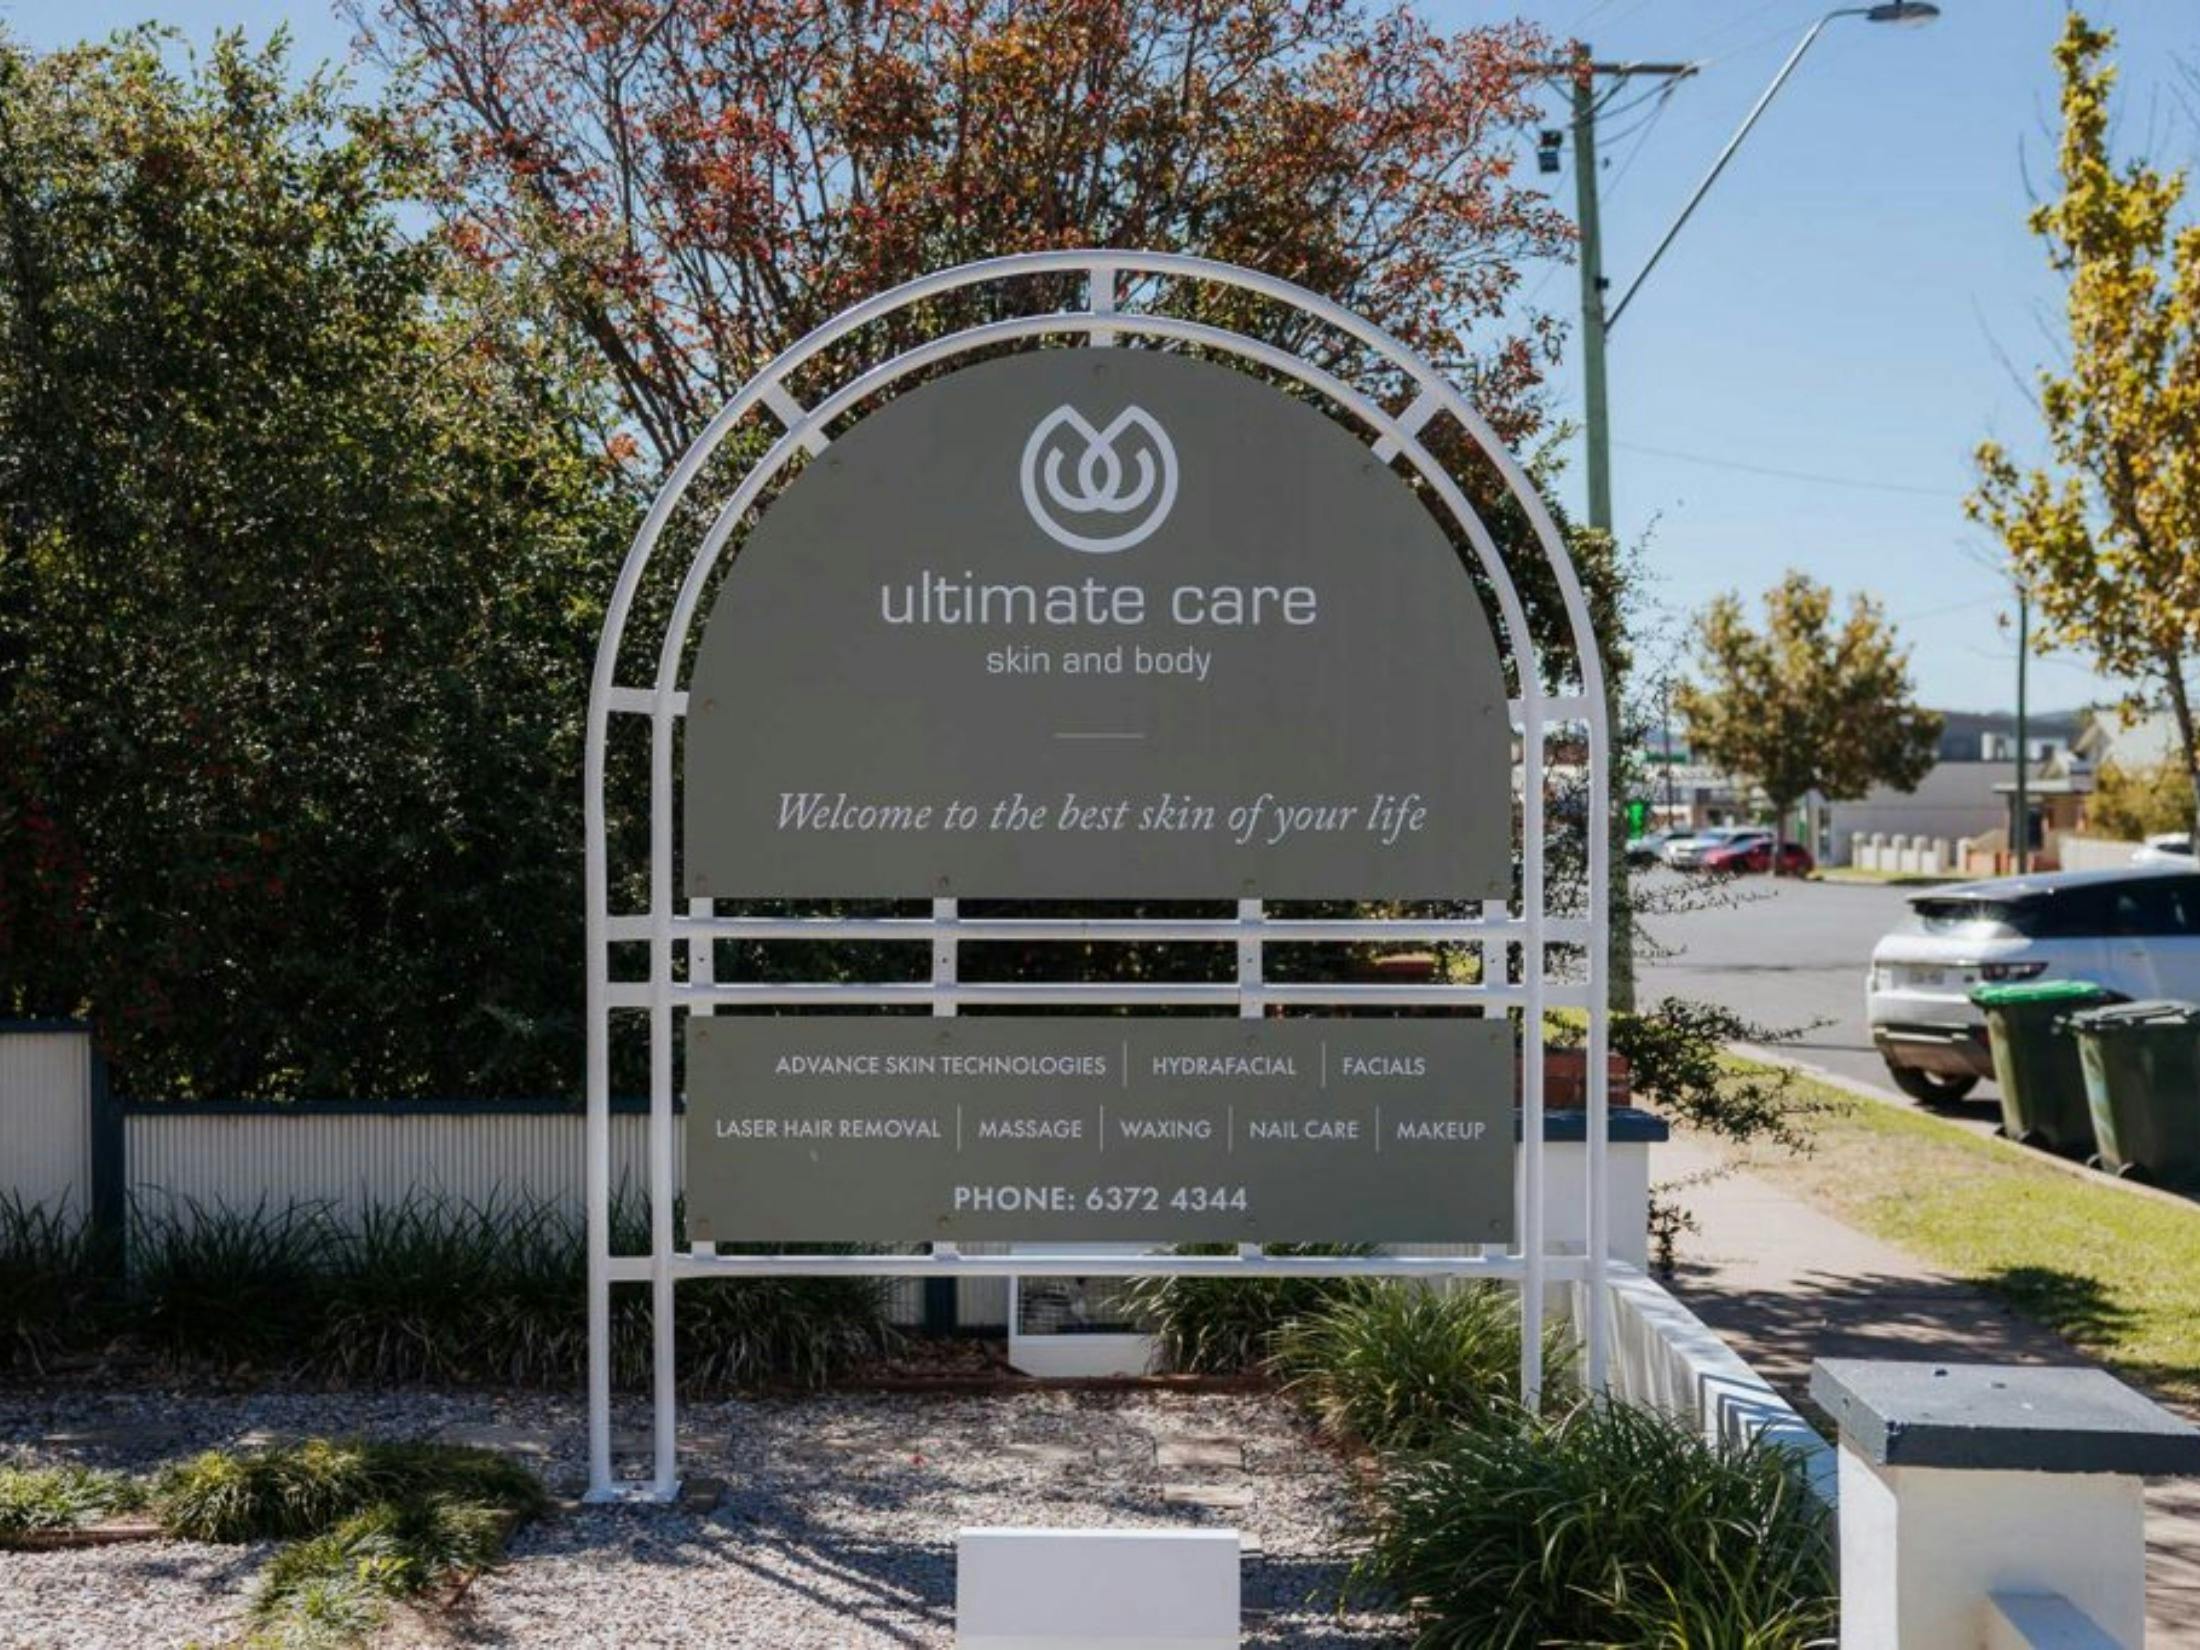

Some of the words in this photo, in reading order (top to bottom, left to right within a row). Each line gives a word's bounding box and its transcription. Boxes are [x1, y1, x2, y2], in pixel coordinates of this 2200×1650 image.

[881, 570, 1145, 625] ultimate
[1172, 586, 1317, 625] care
[986, 645, 1050, 674] skin
[1062, 645, 1123, 674] and
[1135, 645, 1212, 682] body
[777, 792, 933, 831] Welcome
[943, 800, 978, 831] to
[989, 792, 1047, 831] the
[1057, 793, 1129, 831] best
[1138, 793, 1215, 831] skin
[1227, 793, 1274, 845] of
[1268, 806, 1358, 845] your
[1366, 793, 1428, 845] life
[775, 1056, 880, 1075] ADVANCE
[885, 1056, 935, 1075] SKIN
[940, 1056, 1107, 1076] TECHNOLOGIES
[1152, 1056, 1296, 1076] HYDRAFACIAL
[1343, 1056, 1426, 1076] FACIALS
[716, 1119, 777, 1138] LASER
[783, 1119, 833, 1138] HAIR
[839, 1119, 941, 1138] REMOVAL
[978, 1119, 1082, 1139] MASSAGE
[1120, 1119, 1212, 1139] WAXING
[1249, 1120, 1299, 1139] NAIL
[1303, 1120, 1358, 1139] CARE
[1397, 1121, 1486, 1140] MAKEUP
[954, 1186, 1075, 1211] PHONE:
[1085, 1186, 1159, 1211] 6372
[1170, 1186, 1248, 1211] 4344
